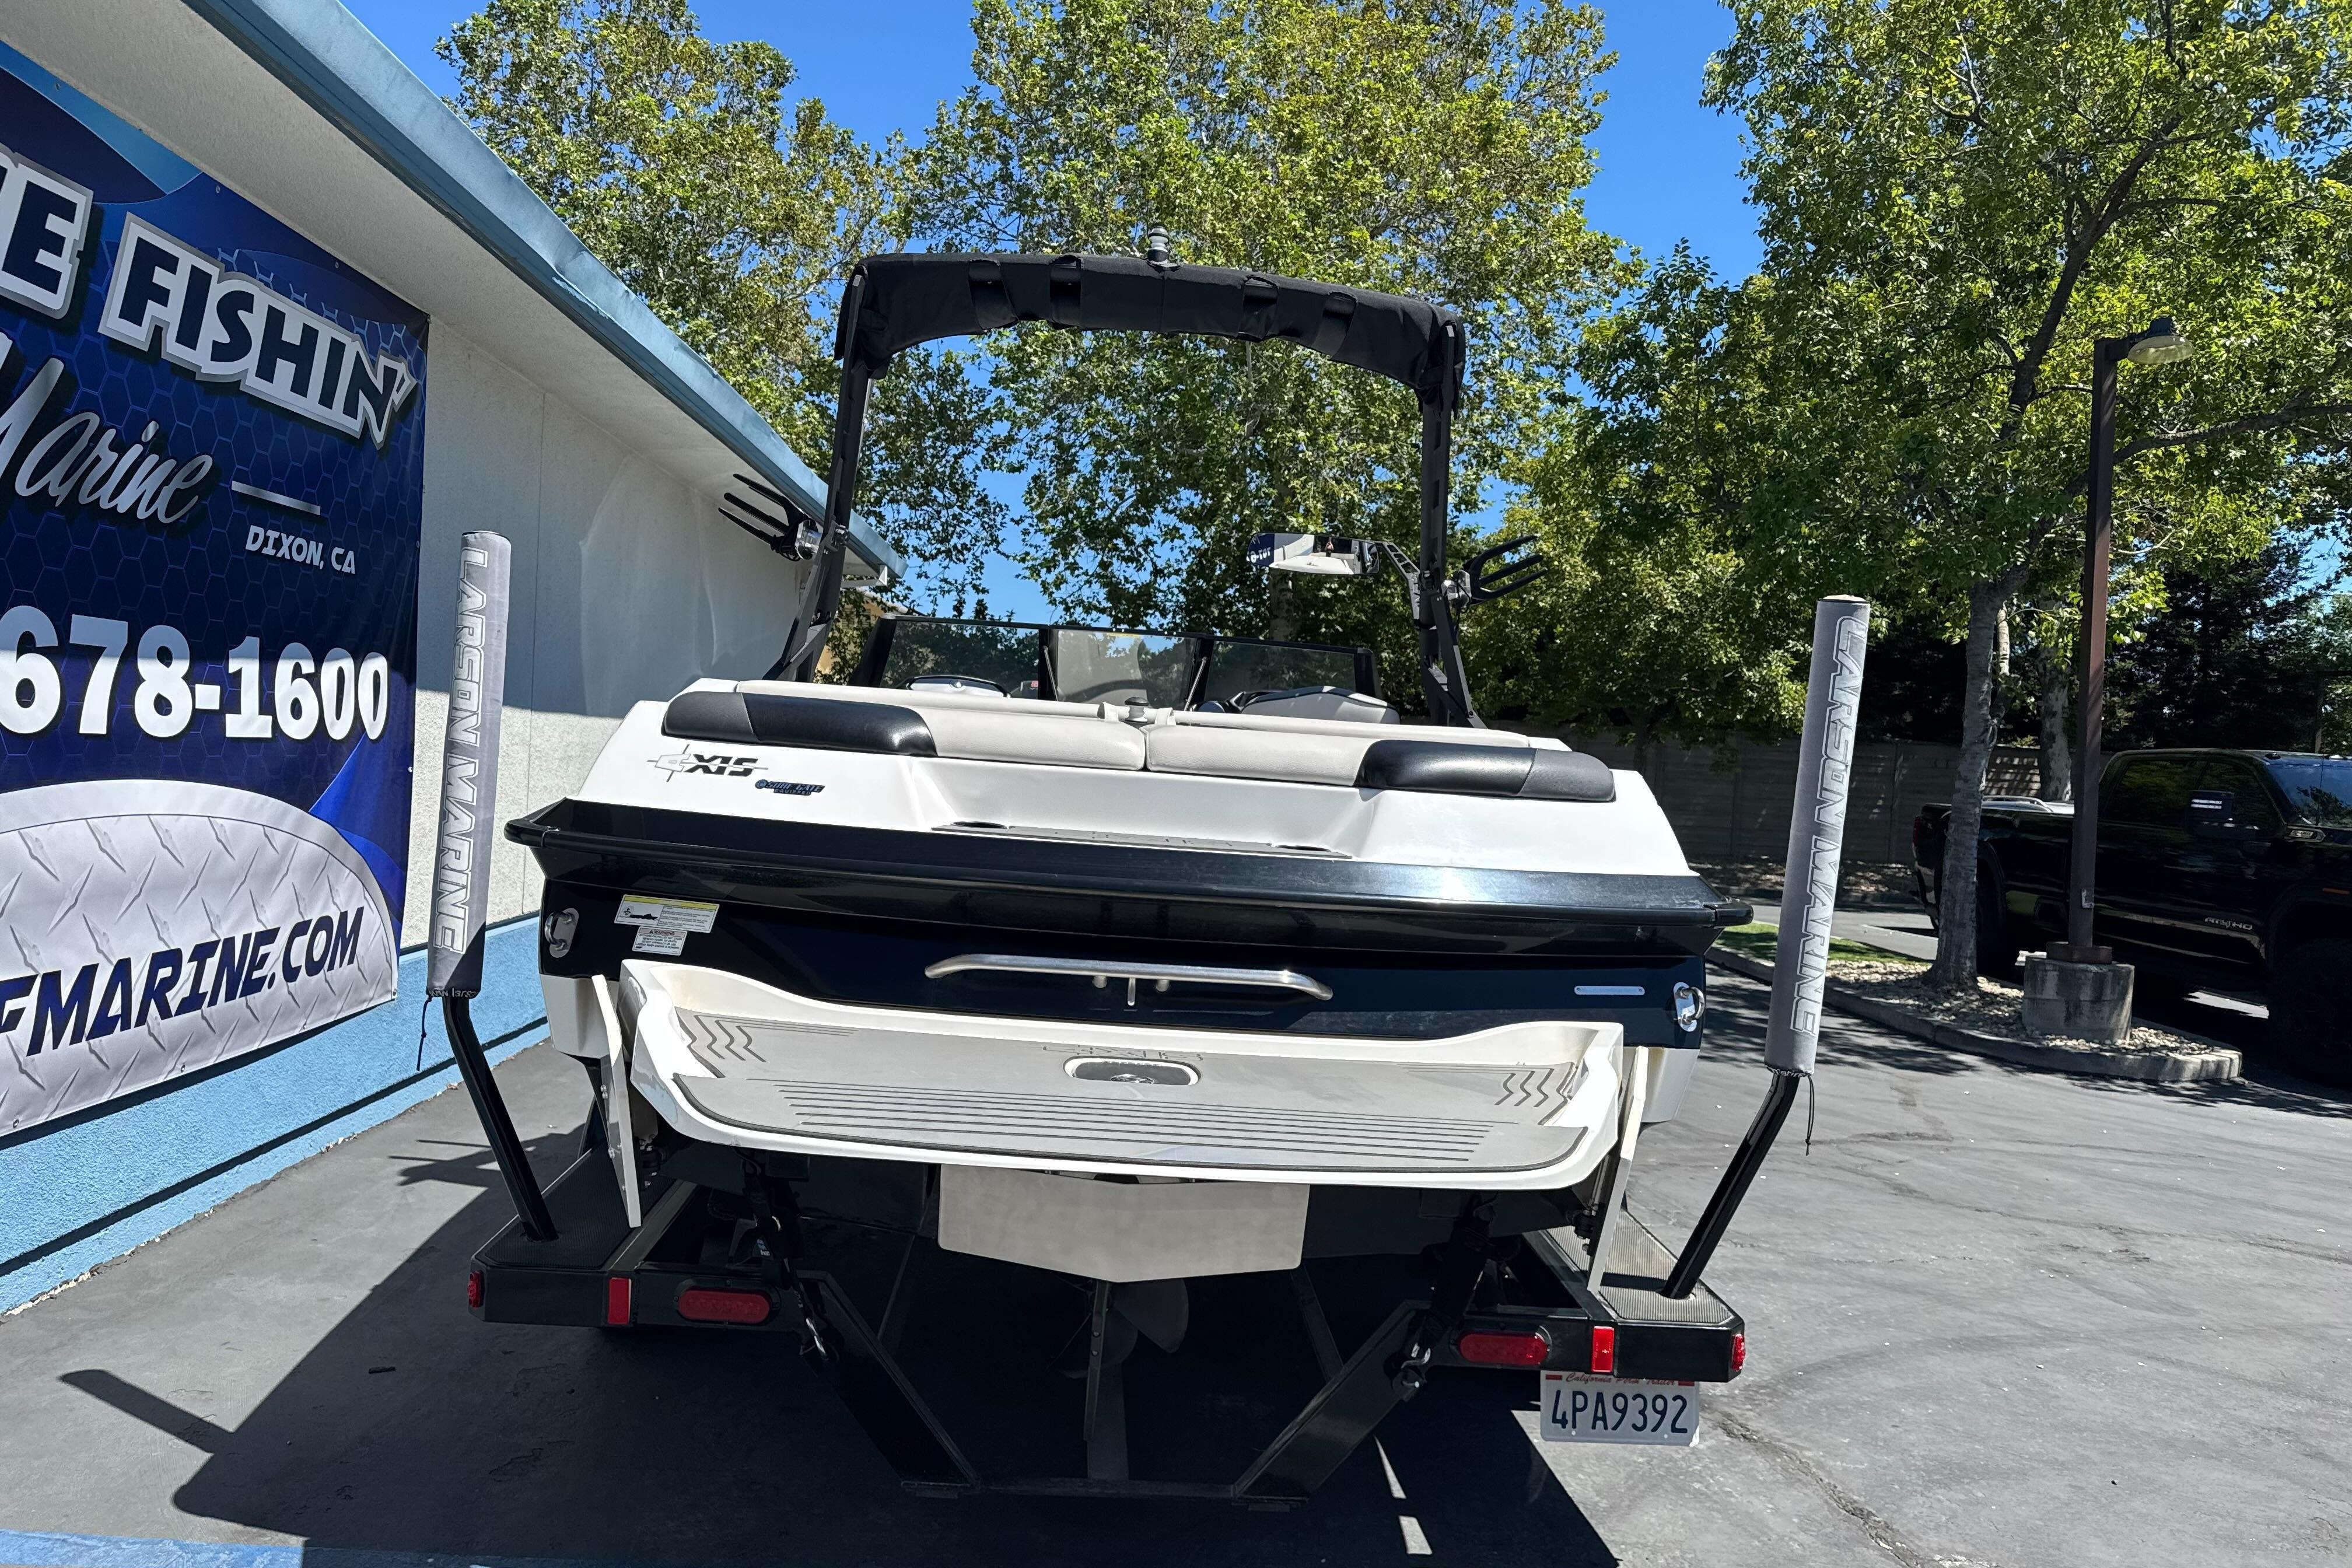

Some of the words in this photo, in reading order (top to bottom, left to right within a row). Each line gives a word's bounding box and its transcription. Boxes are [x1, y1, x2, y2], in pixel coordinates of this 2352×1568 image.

[0, 160, 86, 303] E
[246, 525, 324, 569] DIXON,
[331, 547, 355, 574] CA
[0, 605, 388, 740] 678-1600
[448, 547, 488, 747] LARSON
[654, 753, 758, 777] AXIS
[433, 753, 479, 955] MARINE
[0, 906, 365, 1057] FMARINE.COM
[1552, 1390, 1688, 1434] 4PA9392
[1566, 1372, 1611, 1384] California
